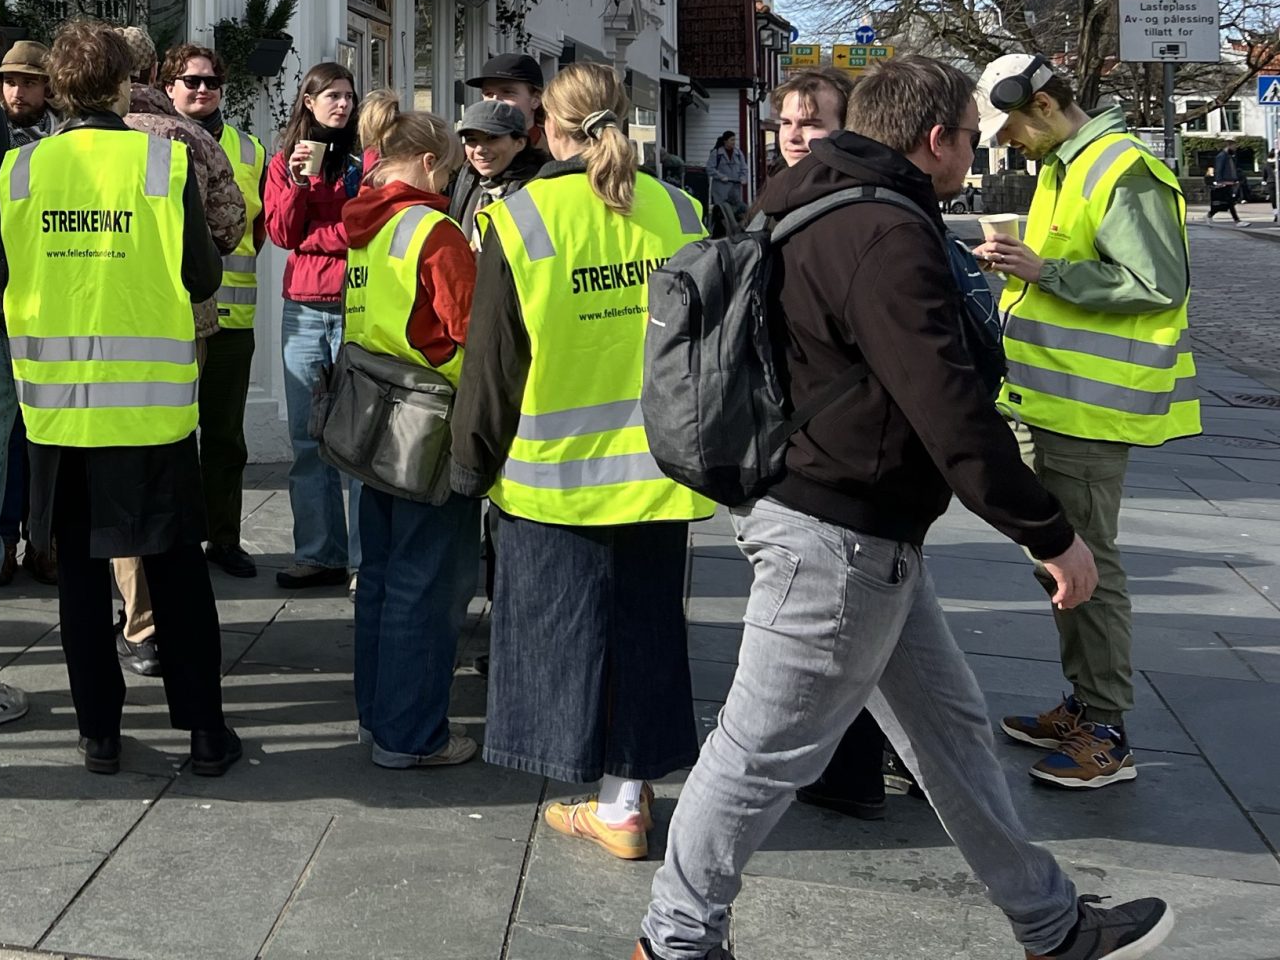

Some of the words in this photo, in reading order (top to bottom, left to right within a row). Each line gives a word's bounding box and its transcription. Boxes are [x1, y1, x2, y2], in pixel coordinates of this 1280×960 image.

[1140, 2, 1197, 12] Lasteplass
[1163, 14, 1214, 25] pålessing
[1144, 28, 1172, 37] tillatt
[1178, 28, 1194, 37] for
[41, 210, 133, 233] STREIKEVAKT
[578, 305, 650, 321] www.fellesforbu
[1091, 750, 1112, 768] N
